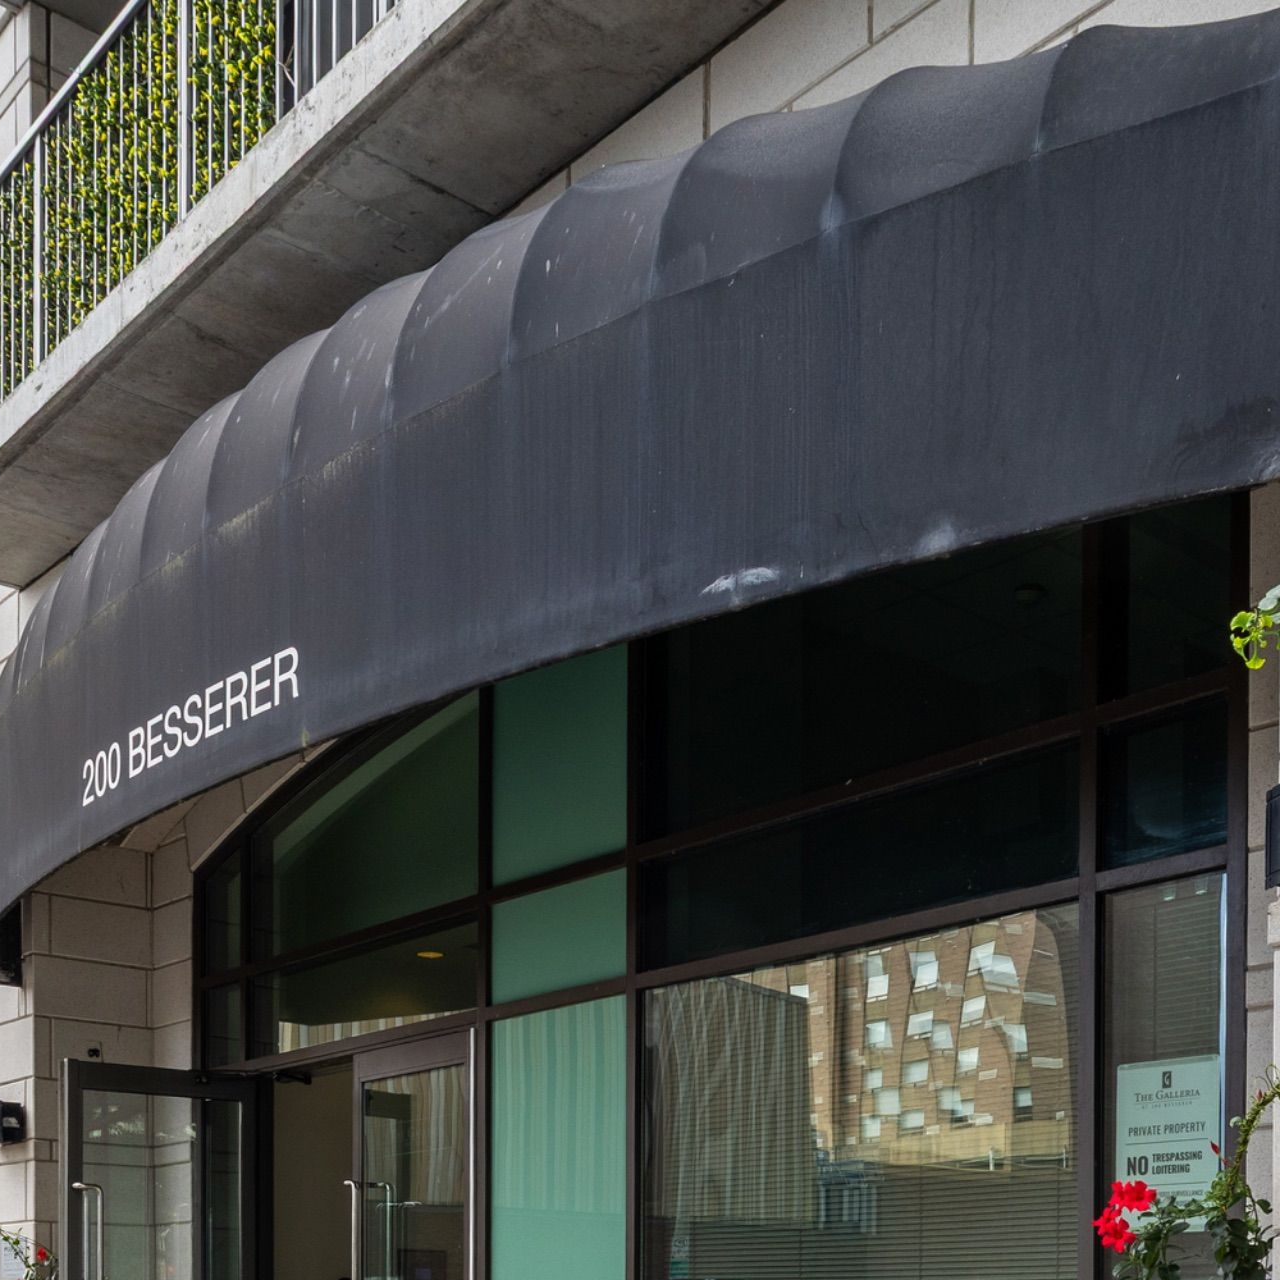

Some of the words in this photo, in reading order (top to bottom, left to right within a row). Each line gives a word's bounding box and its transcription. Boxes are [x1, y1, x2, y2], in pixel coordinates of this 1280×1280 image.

[82, 742, 120, 807] 200
[128, 646, 299, 779] BESSERER
[1134, 1093, 1154, 1103] THE
[1155, 1088, 1200, 1100] GALLERIA
[1128, 1125, 1161, 1137] PRIVATE
[1163, 1121, 1206, 1134] PROPERTY
[1152, 1151, 1203, 1163] TRESPASSING
[1127, 1155, 1149, 1177] NO
[1152, 1163, 1191, 1175] LOITERING
